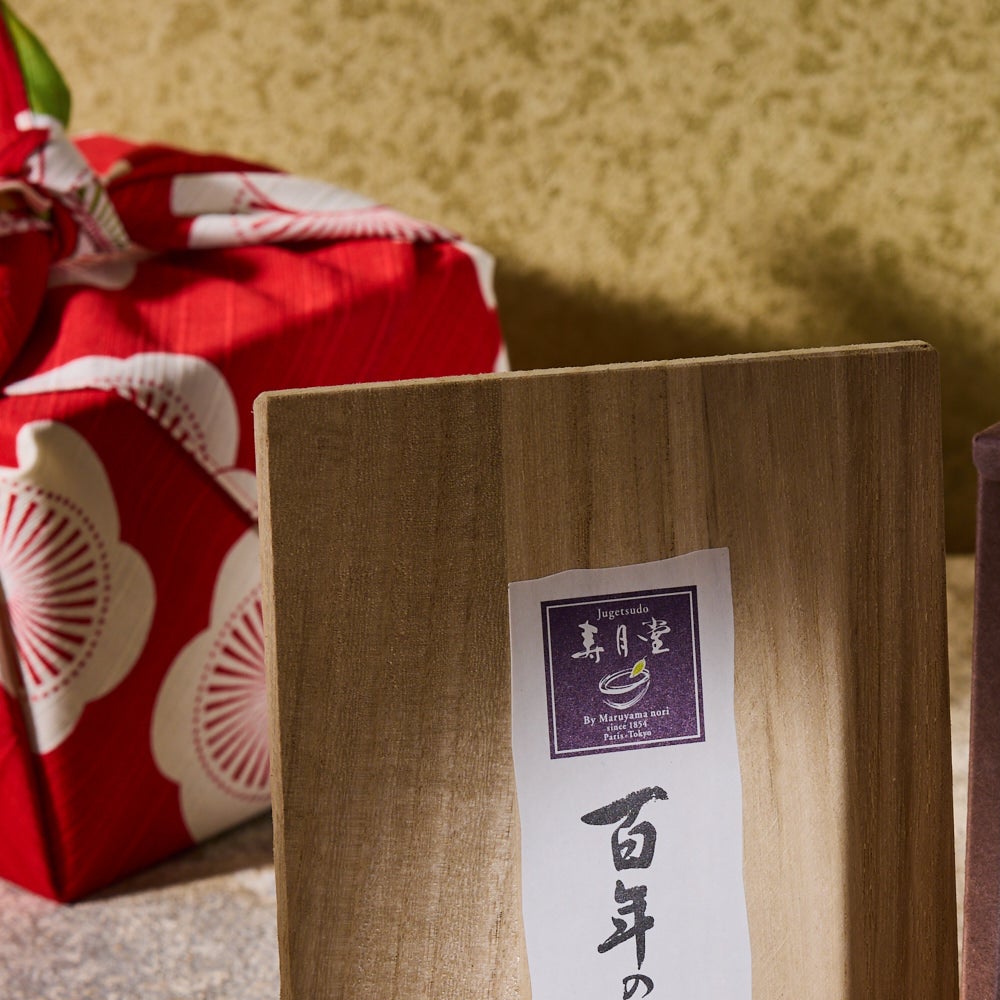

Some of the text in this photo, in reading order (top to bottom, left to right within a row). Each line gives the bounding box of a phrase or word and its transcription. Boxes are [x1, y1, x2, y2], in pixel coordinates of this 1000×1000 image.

[597, 604, 649, 620] Jugetsudo
[583, 706, 670, 726] By Maruyama nori
[606, 720, 647, 732] since 1854
